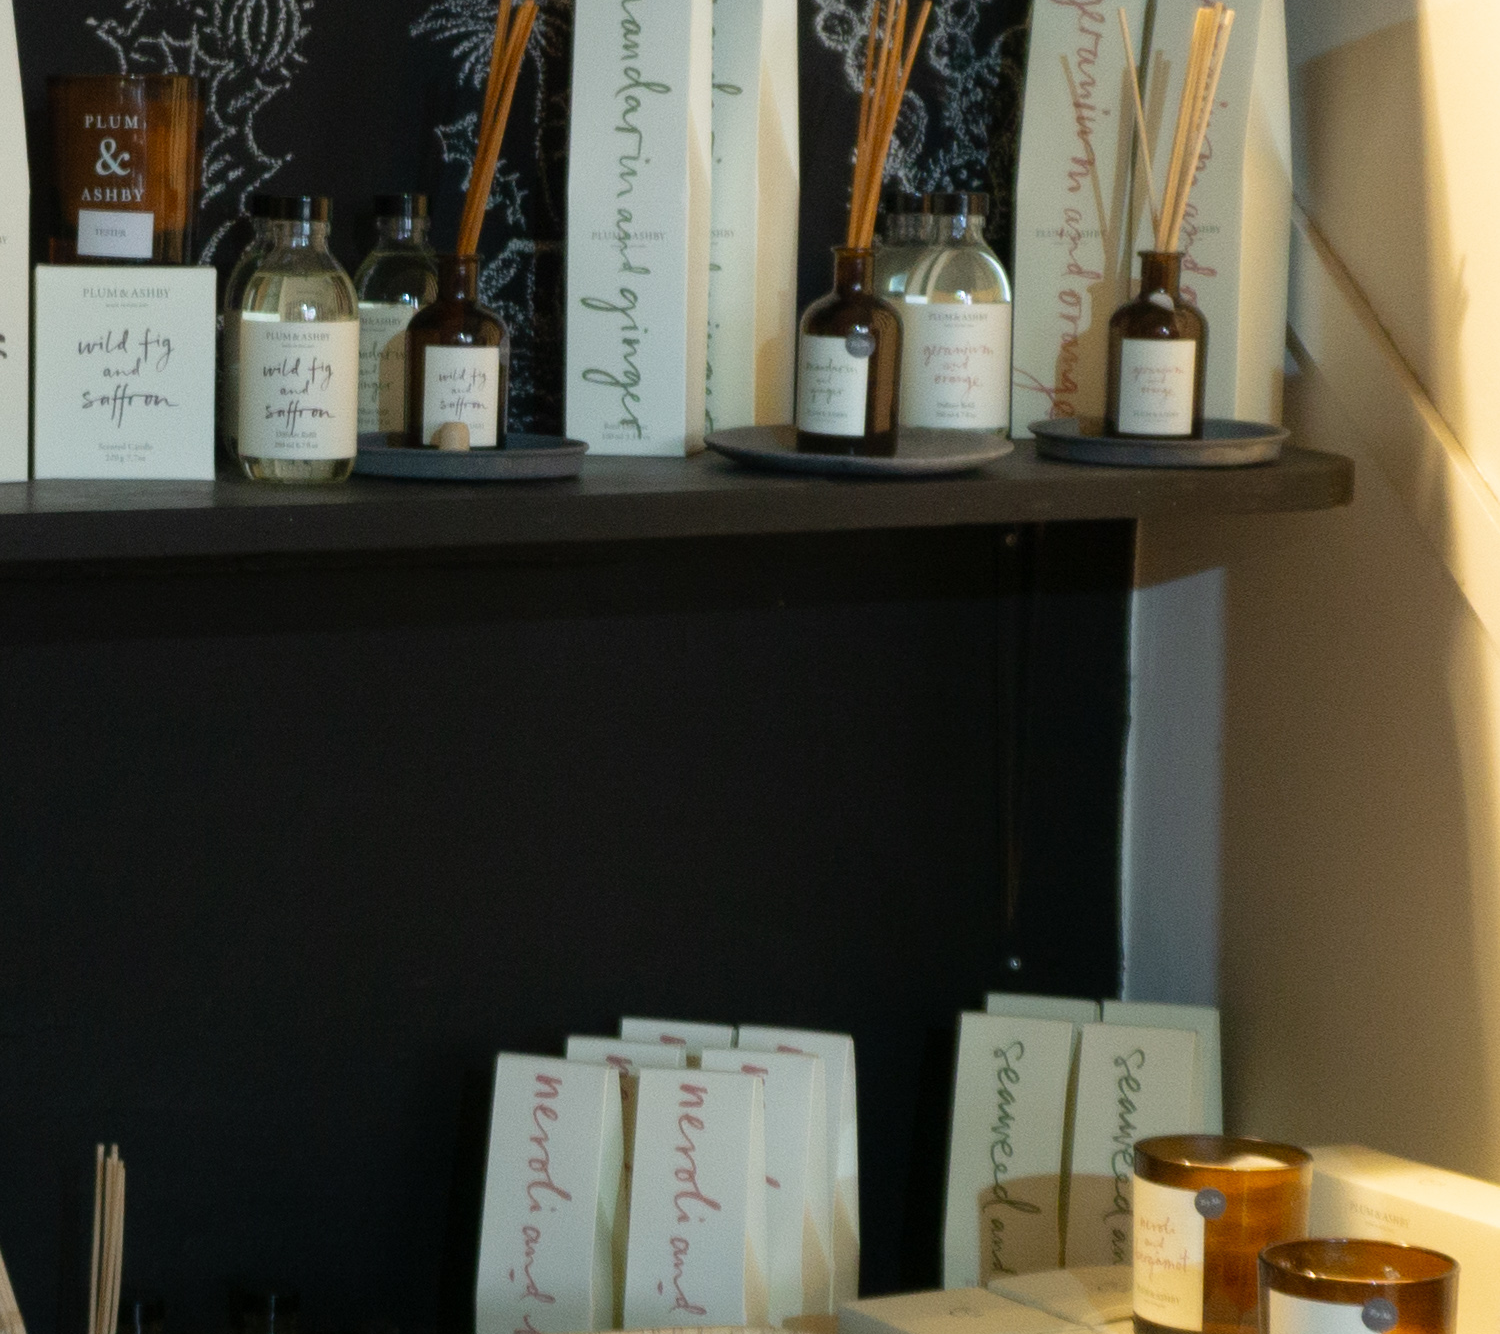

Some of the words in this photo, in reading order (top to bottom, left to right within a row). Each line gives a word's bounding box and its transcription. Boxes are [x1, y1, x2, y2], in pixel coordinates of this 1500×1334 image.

[84, 116, 140, 130] PLUM
[96, 139, 130, 176] &
[81, 187, 144, 202] ASHBY
[617, 208, 651, 275] and
[1066, 207, 1103, 288] and
[82, 288, 118, 299] PLUM
[119, 288, 130, 299] &
[130, 288, 170, 299] ASHBY
[78, 329, 128, 358] wild
[138, 328, 175, 363] fig
[580, 287, 648, 440] ginger
[102, 362, 141, 379] and
[263, 359, 300, 380] wild
[309, 360, 334, 384] fig
[279, 380, 309, 396] and
[438, 370, 465, 387] wild
[80, 386, 180, 429] saffron
[264, 398, 336, 434] saffron
[439, 397, 488, 416] saffron
[525, 1073, 574, 1215] neroli
[982, 1041, 1043, 1214] seaweed
[678, 1081, 721, 1215] neroli
[521, 1224, 558, 1304] and
[668, 1235, 706, 1316] and
